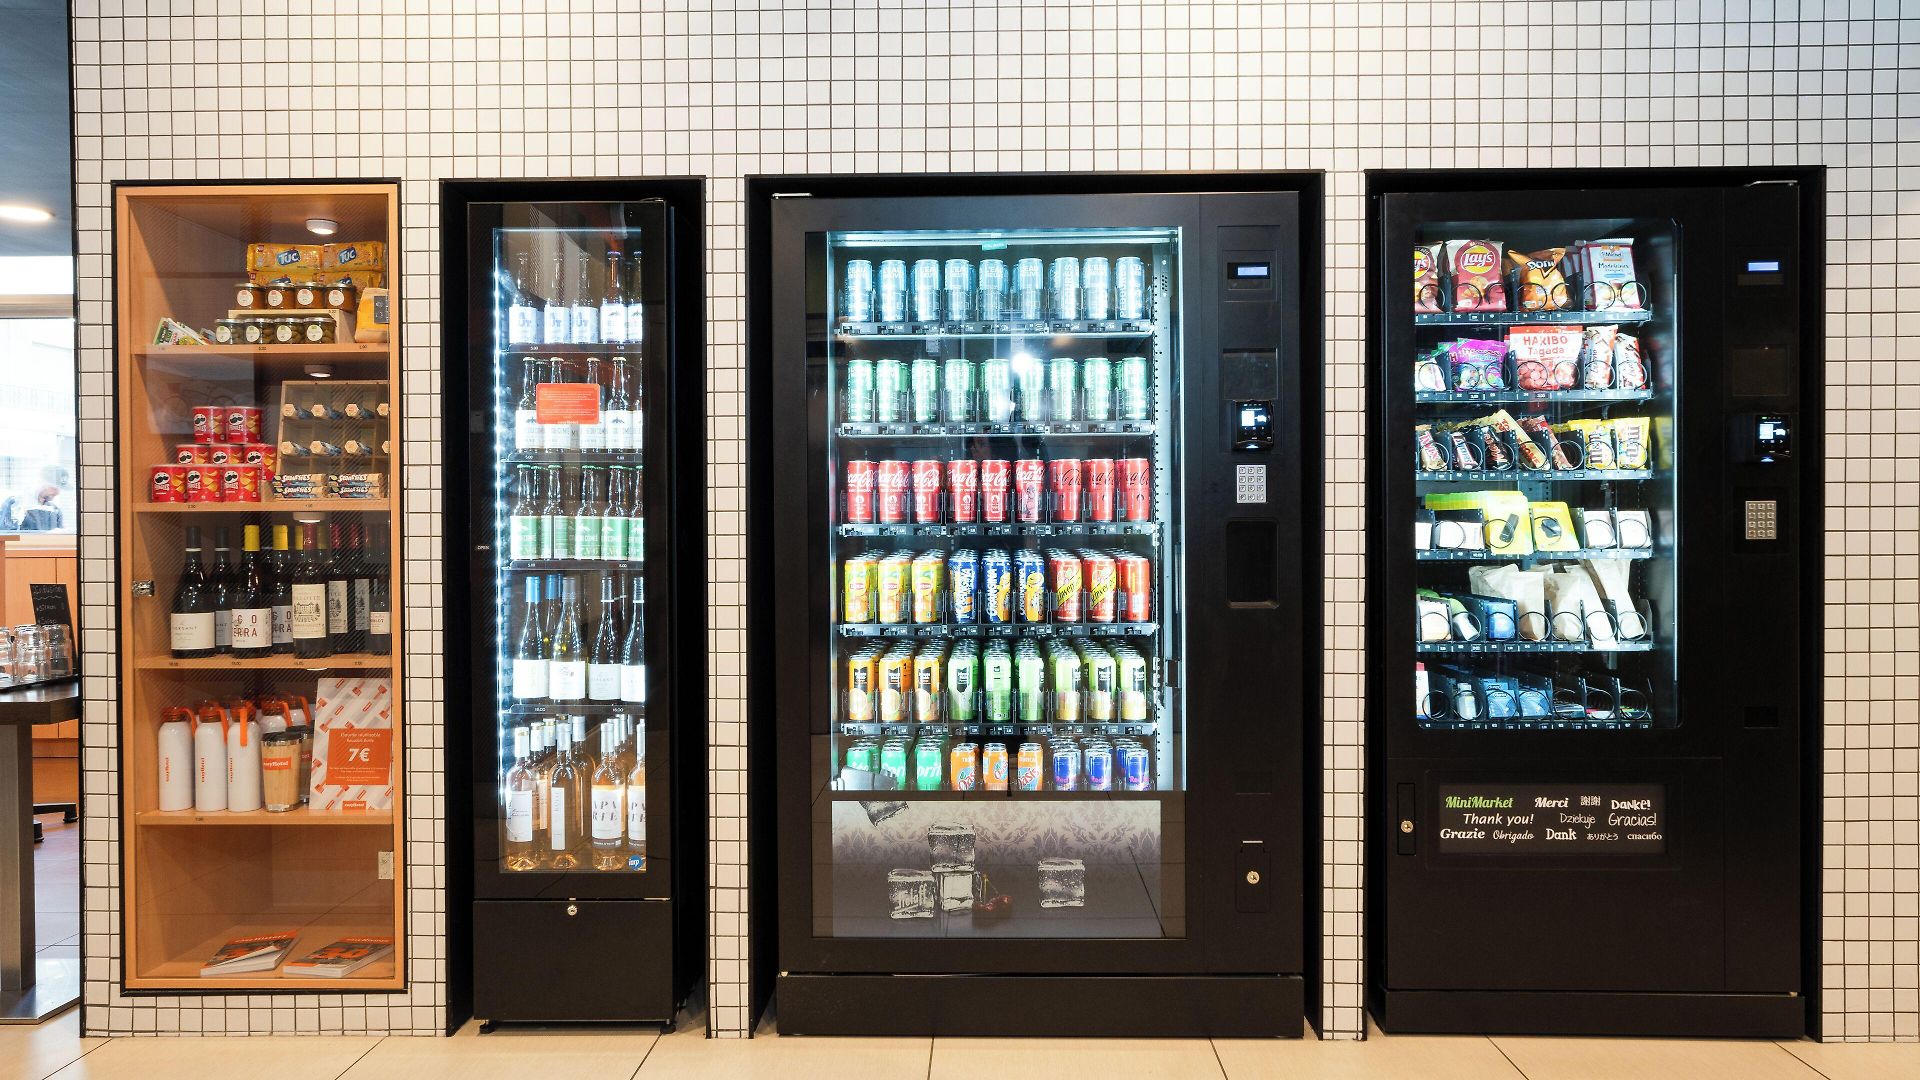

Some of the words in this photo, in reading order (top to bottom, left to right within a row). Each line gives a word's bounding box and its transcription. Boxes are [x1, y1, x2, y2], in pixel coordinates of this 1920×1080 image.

[278, 251, 299, 264] TUC
[340, 250, 357, 264] TUC
[1523, 335, 1568, 346] HARIBO
[348, 748, 370, 762] 7€
[1446, 796, 1513, 808] MiniMarket
[1535, 797, 1569, 808] Merci
[1580, 796, 1601, 807] 謝謝
[1463, 813, 1502, 824] Thank
[1507, 813, 1535, 827] you!
[1608, 813, 1657, 826] Gracias!
[1440, 828, 1486, 839] Grazie
[1493, 830, 1535, 843] Obrigado
[1546, 828, 1578, 840] Dank
[1627, 832, 1663, 840] спасибо
